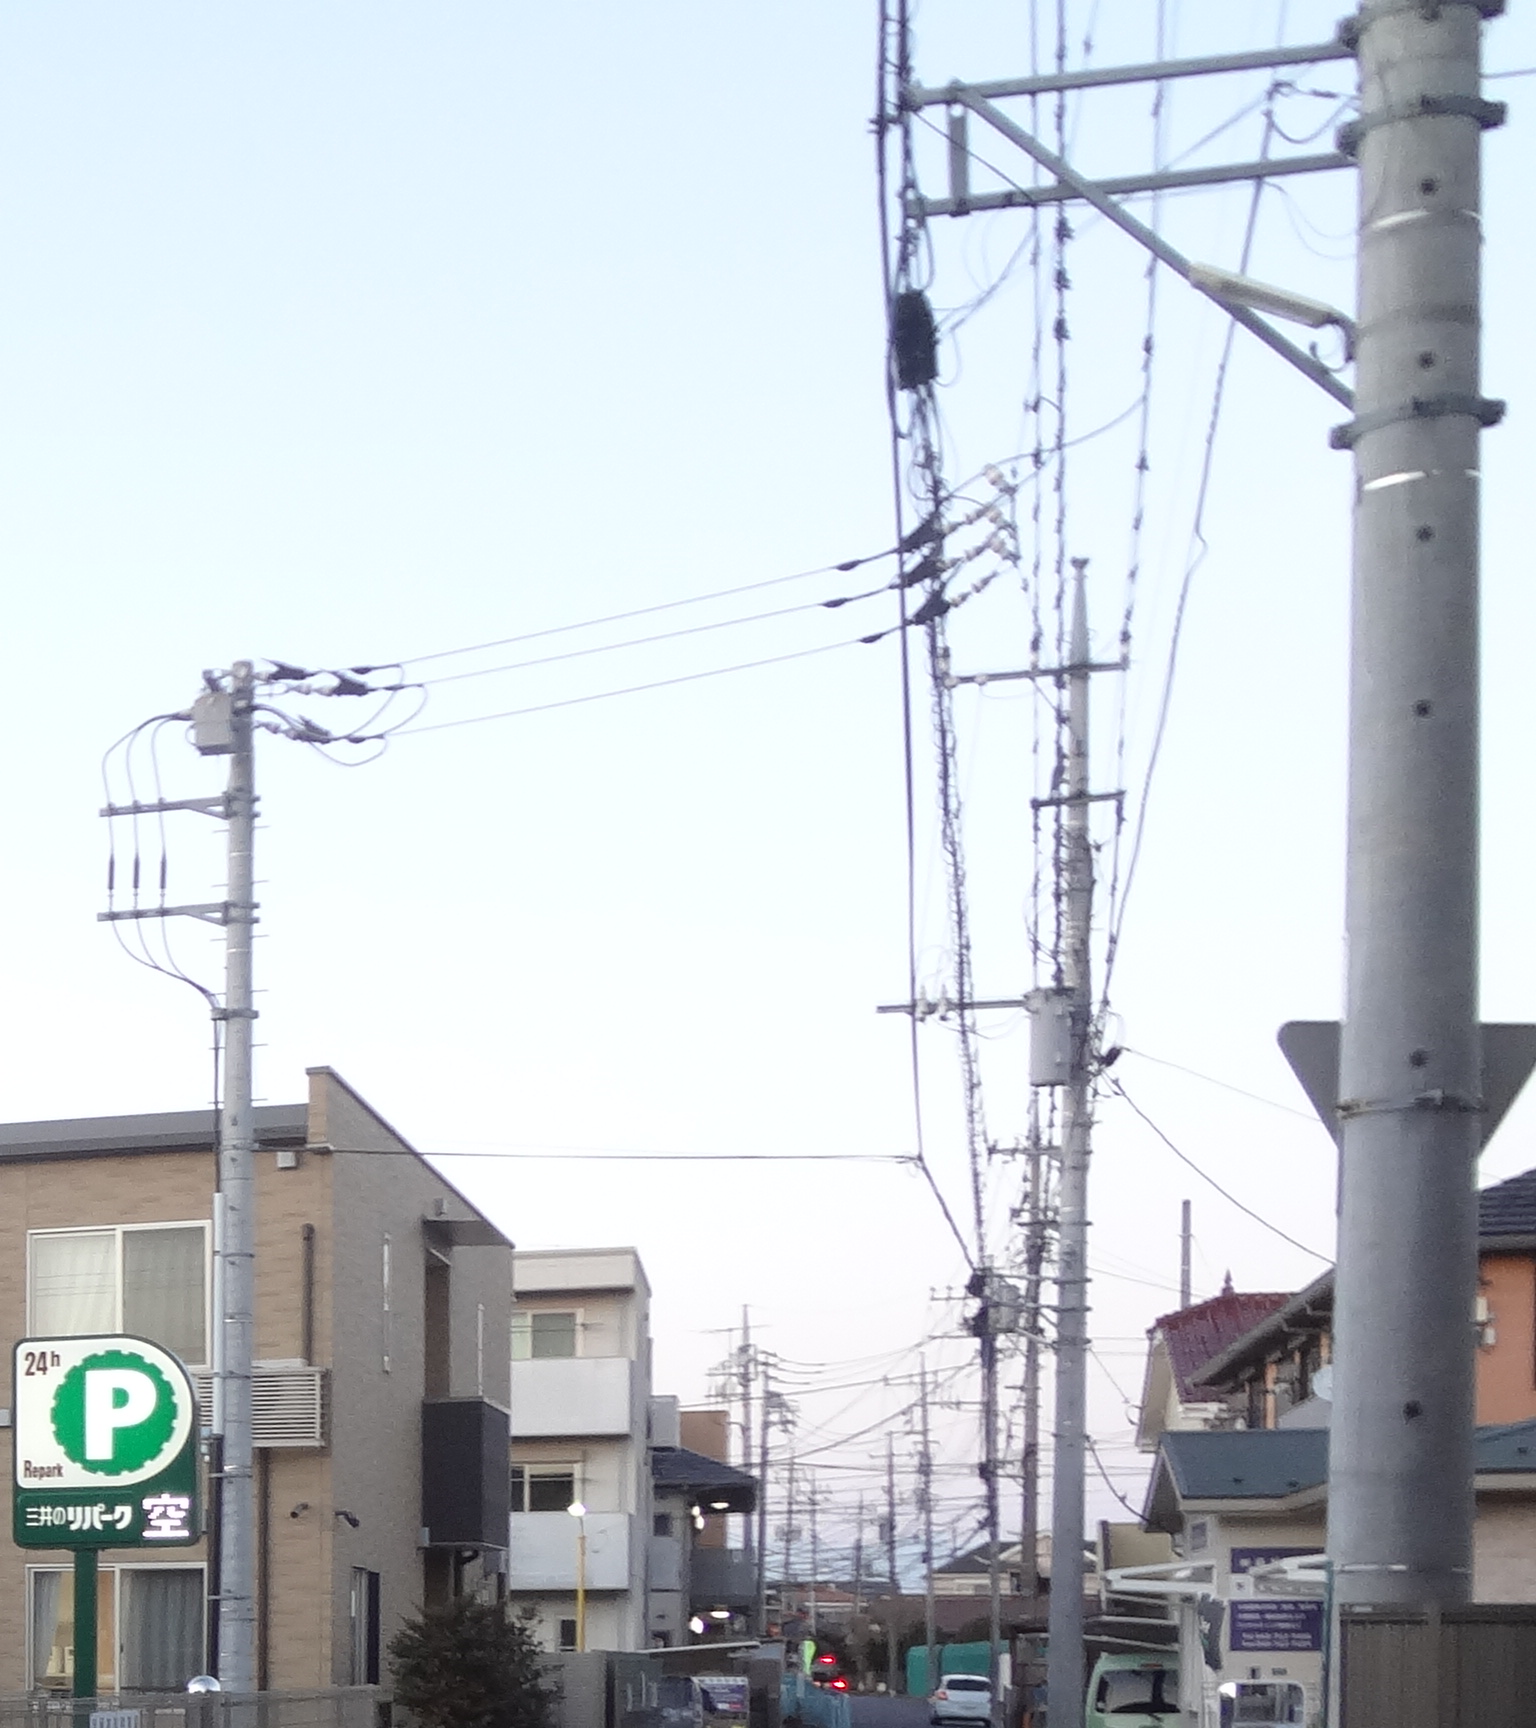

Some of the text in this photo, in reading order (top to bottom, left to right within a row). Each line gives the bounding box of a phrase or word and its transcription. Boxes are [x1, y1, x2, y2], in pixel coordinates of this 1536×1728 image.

[85, 1369, 157, 1461] P
[23, 1460, 64, 1481] Repark
[25, 1503, 133, 1531] 三井のリパーク
[141, 1493, 190, 1539] 空
